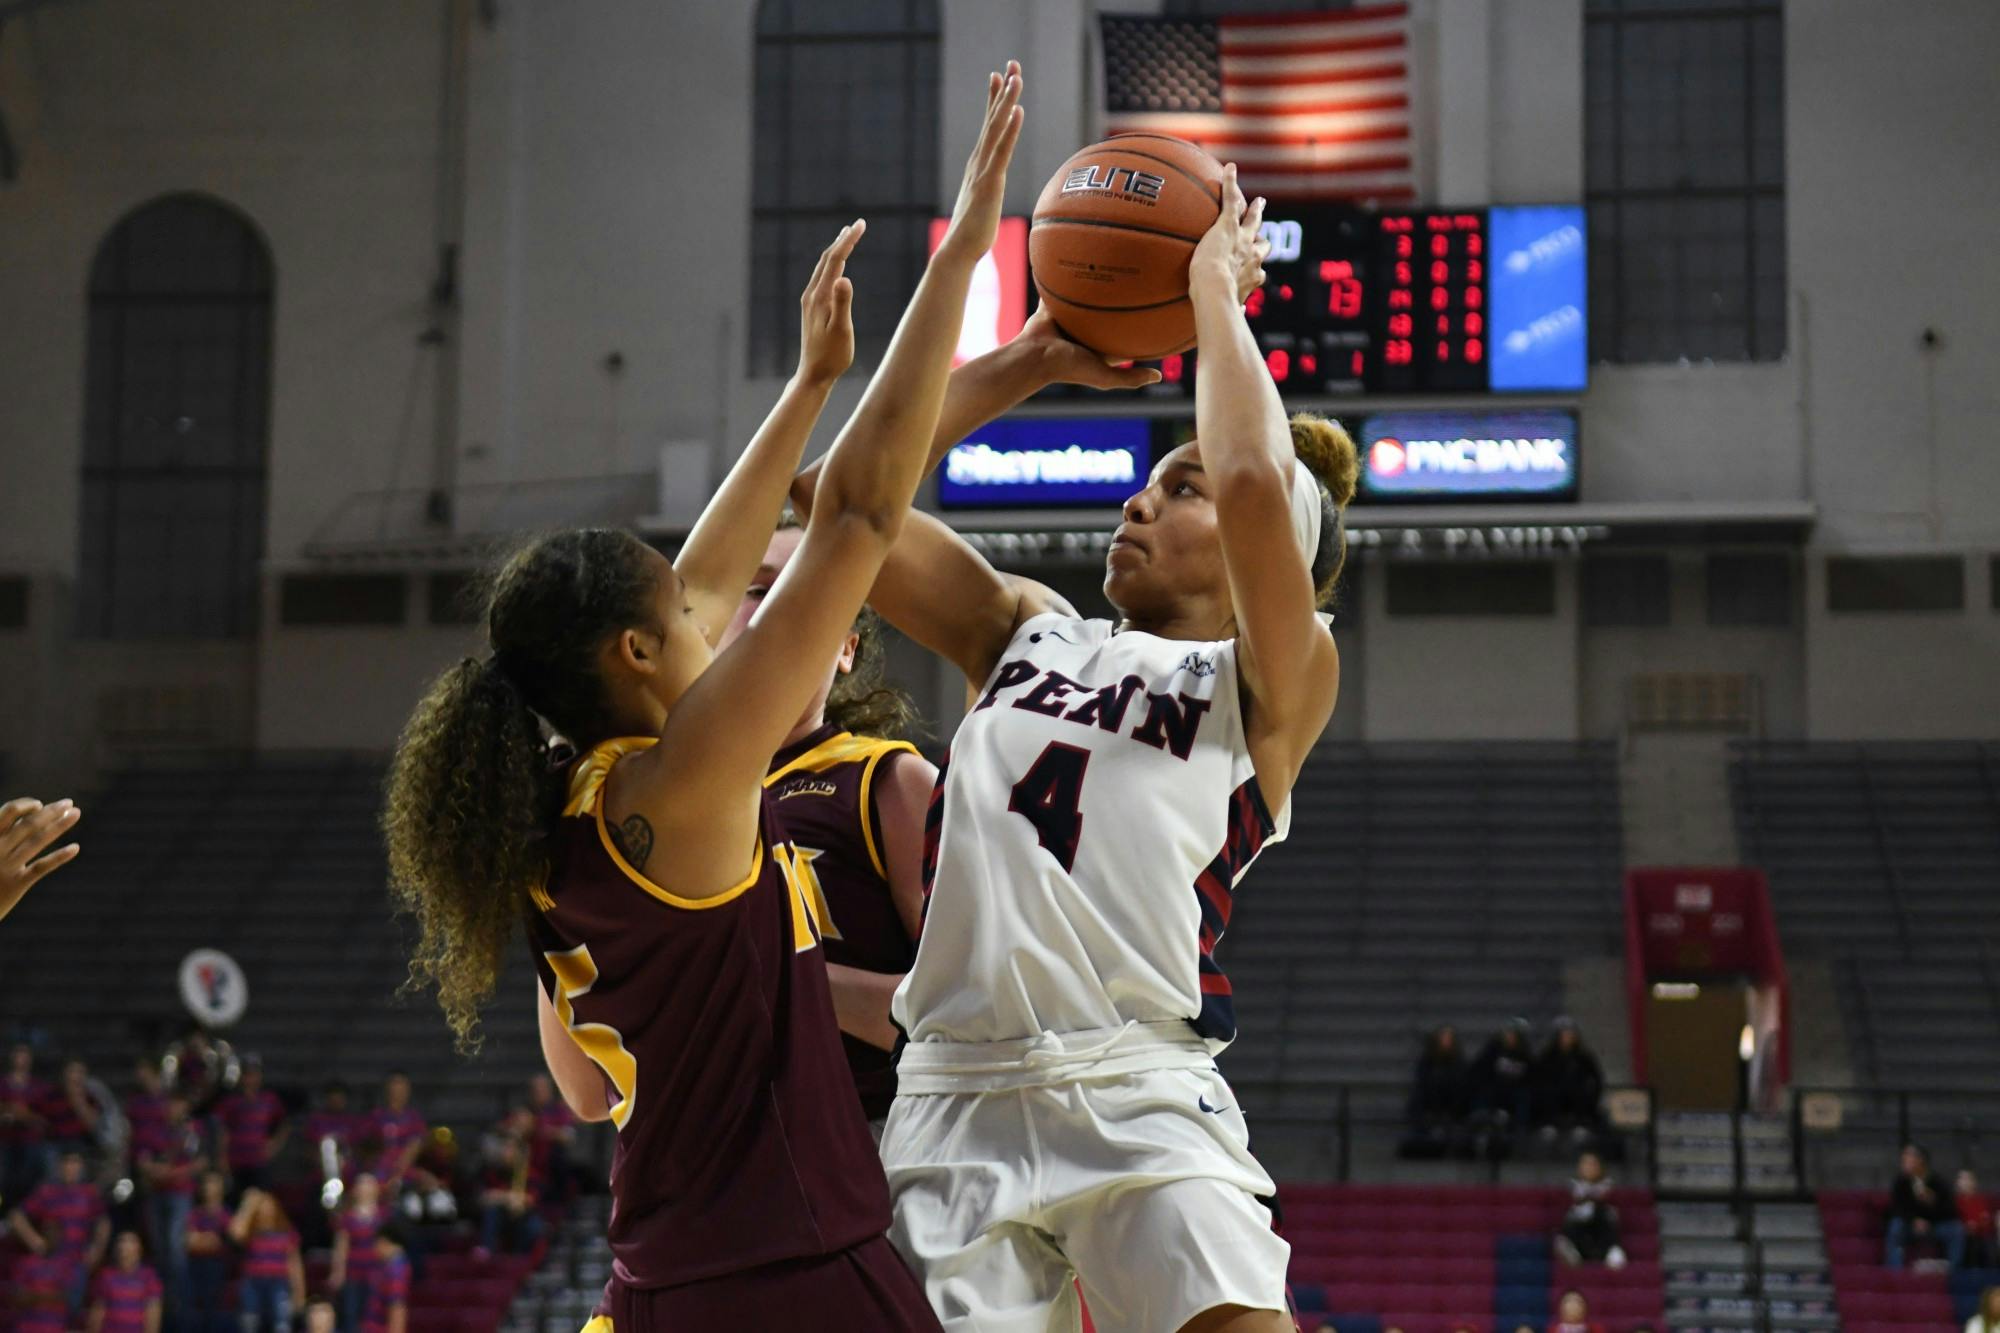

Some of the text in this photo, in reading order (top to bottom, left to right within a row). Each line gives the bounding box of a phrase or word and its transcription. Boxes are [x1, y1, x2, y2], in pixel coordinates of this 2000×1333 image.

[1061, 164, 1165, 201] ELITE
[974, 659, 1211, 762] PENN
[1007, 740, 1092, 875] 4
